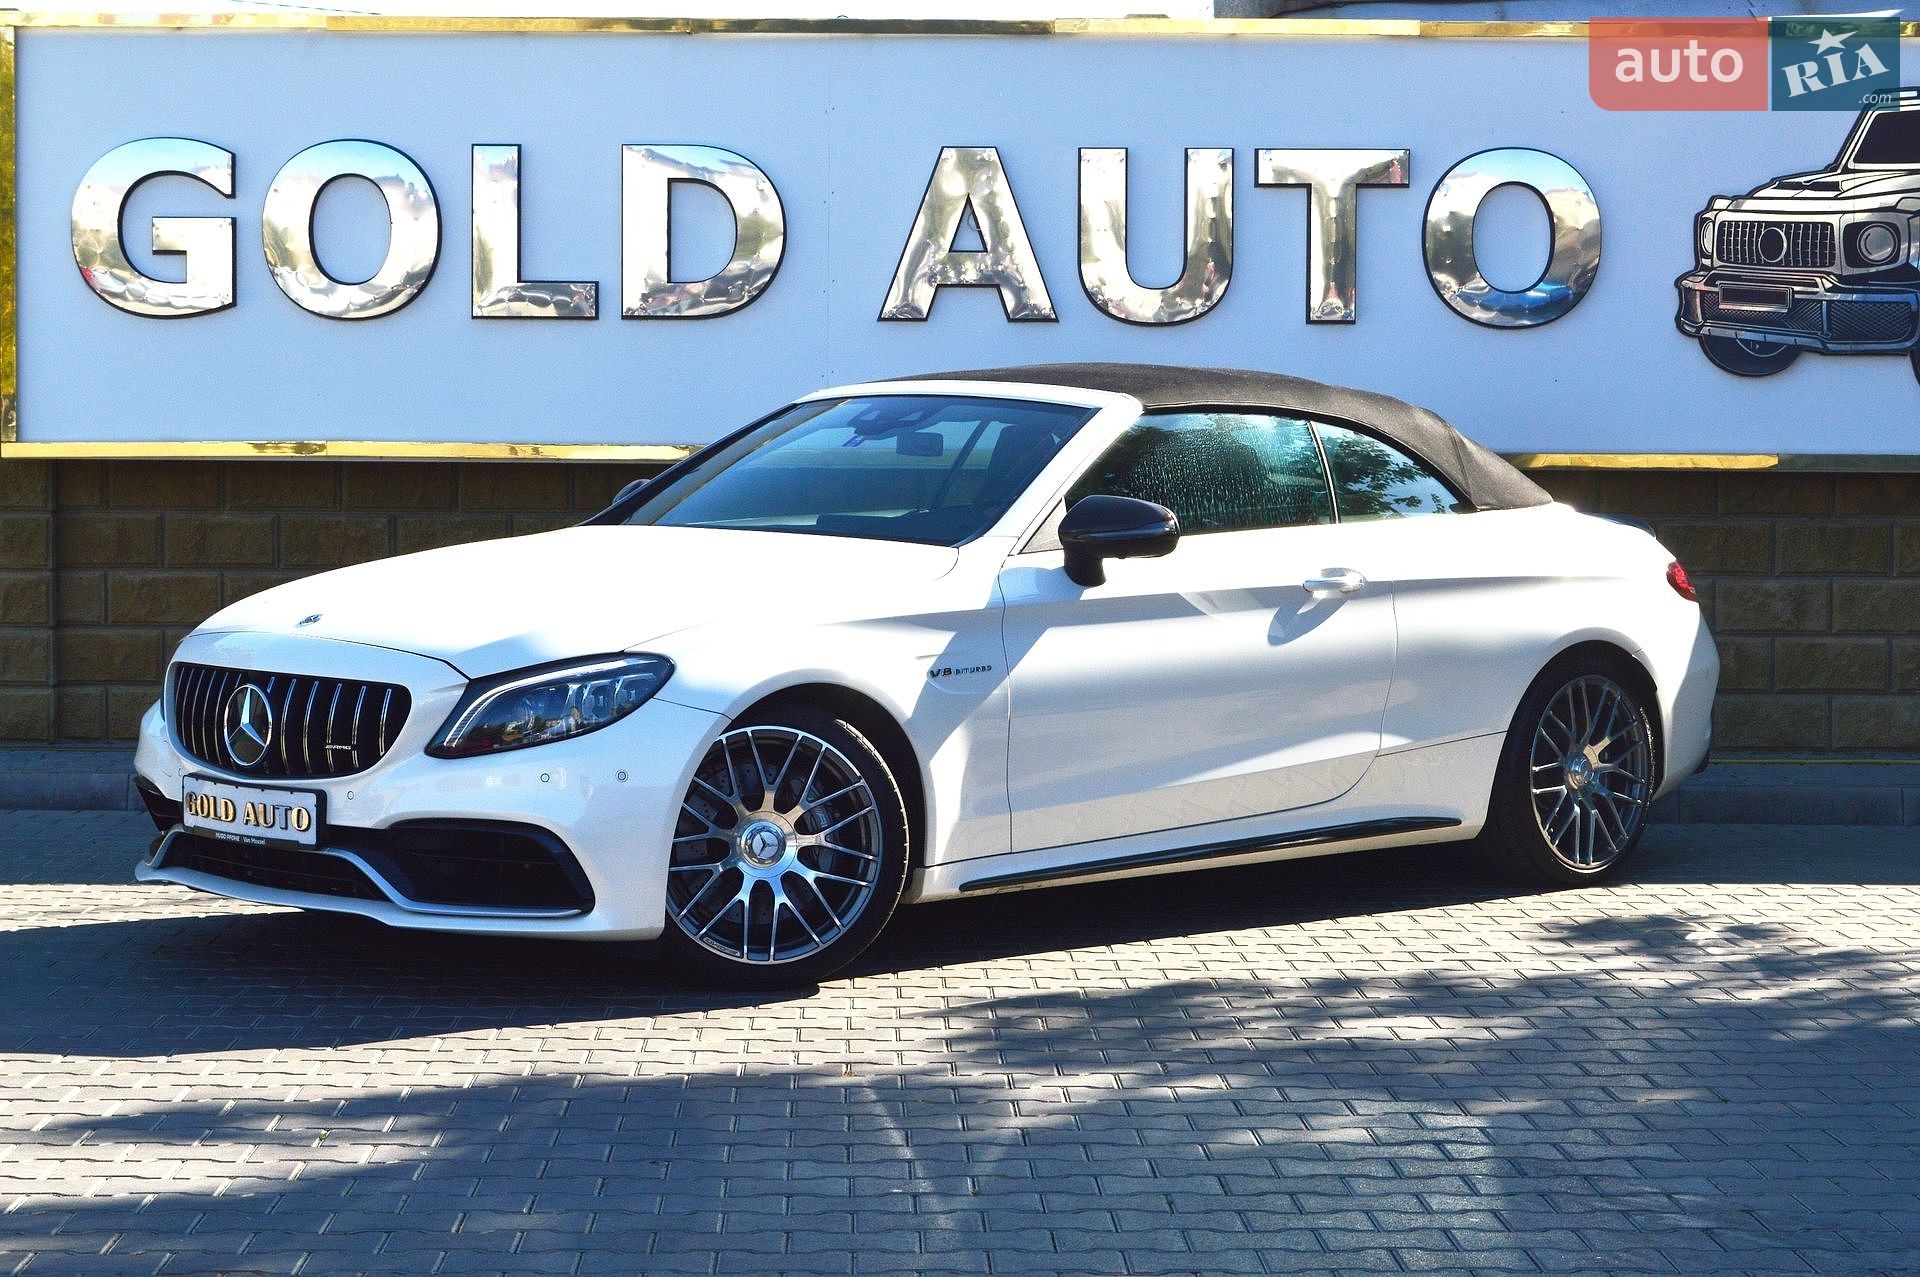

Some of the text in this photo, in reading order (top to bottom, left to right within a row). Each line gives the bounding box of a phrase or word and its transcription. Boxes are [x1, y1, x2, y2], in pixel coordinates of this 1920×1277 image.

[71, 137, 1602, 329] GOLD AUTO
[930, 665, 992, 678] V8 BITURBO
[185, 791, 311, 832] GOLD AUTO
